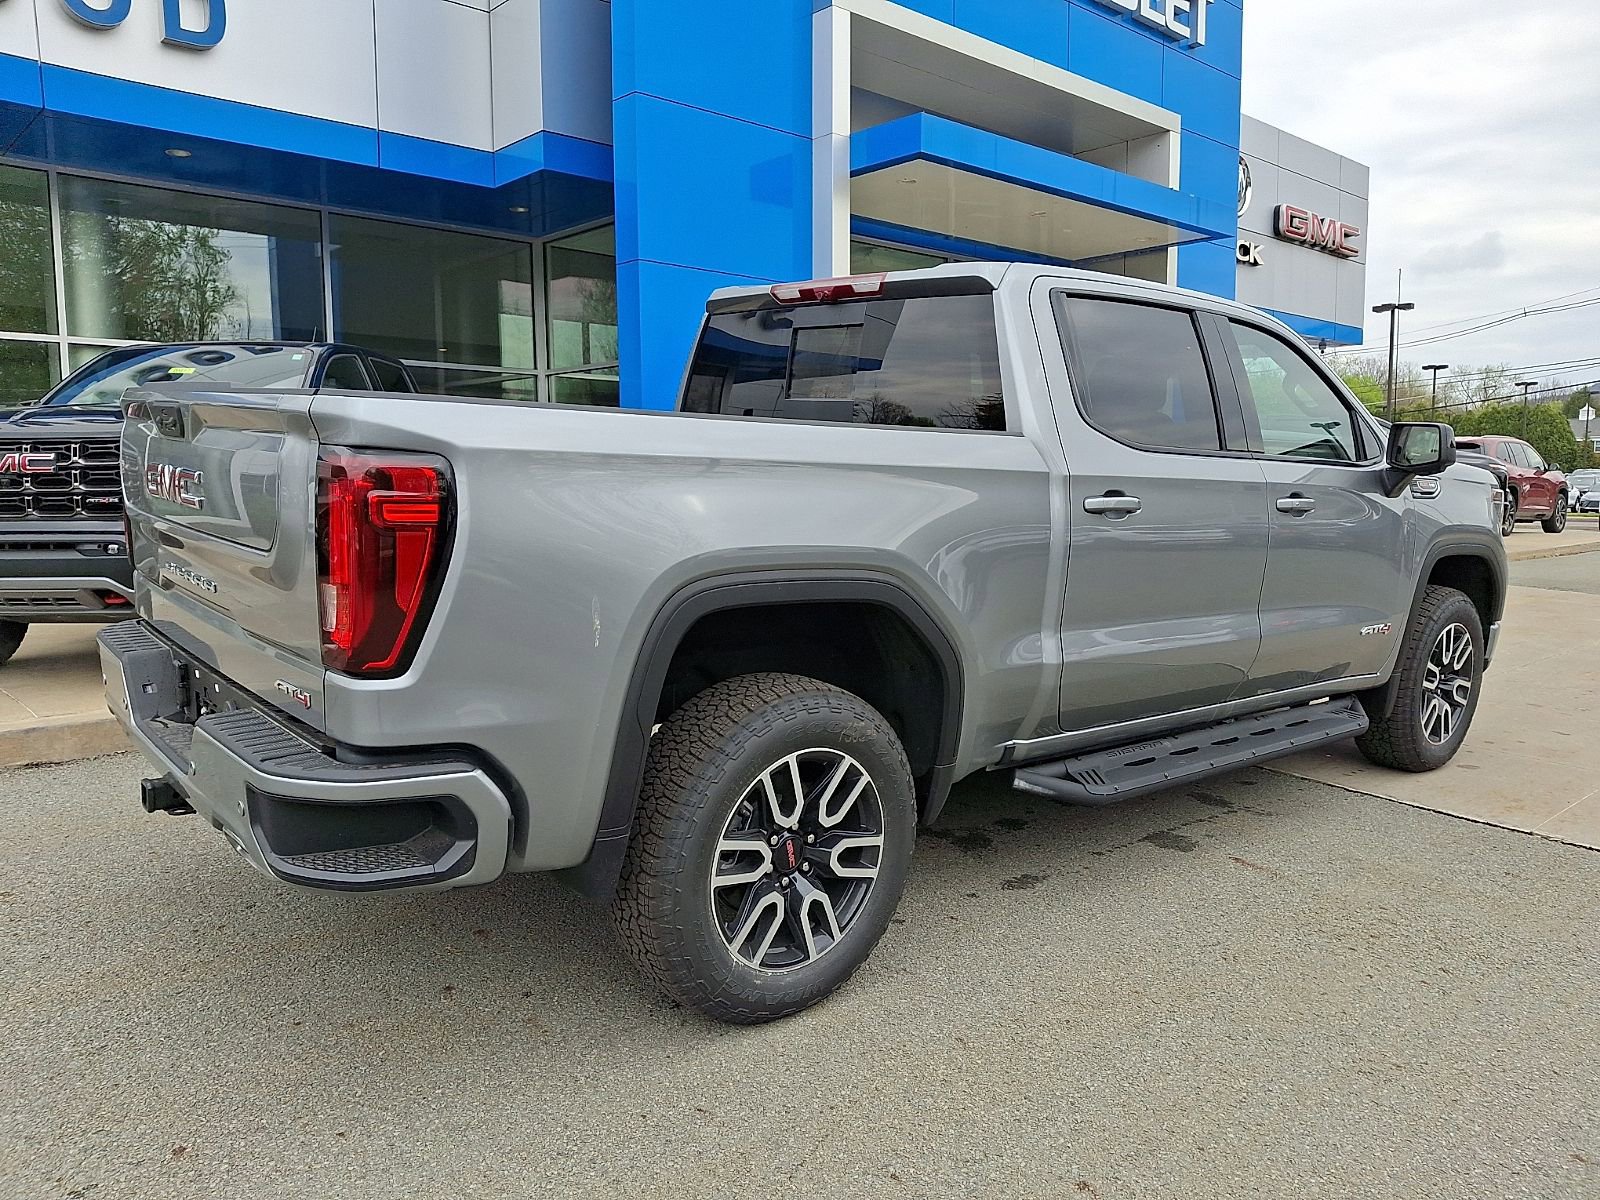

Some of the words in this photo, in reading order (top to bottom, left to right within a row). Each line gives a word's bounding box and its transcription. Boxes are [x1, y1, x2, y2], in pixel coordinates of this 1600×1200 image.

[1276, 203, 1360, 257] GMC
[146, 463, 205, 510] GMC
[1360, 622, 1393, 636] AT4
[273, 679, 312, 710] AT4
[1106, 740, 1164, 758] SIERRA
[786, 839, 796, 869] GMC
